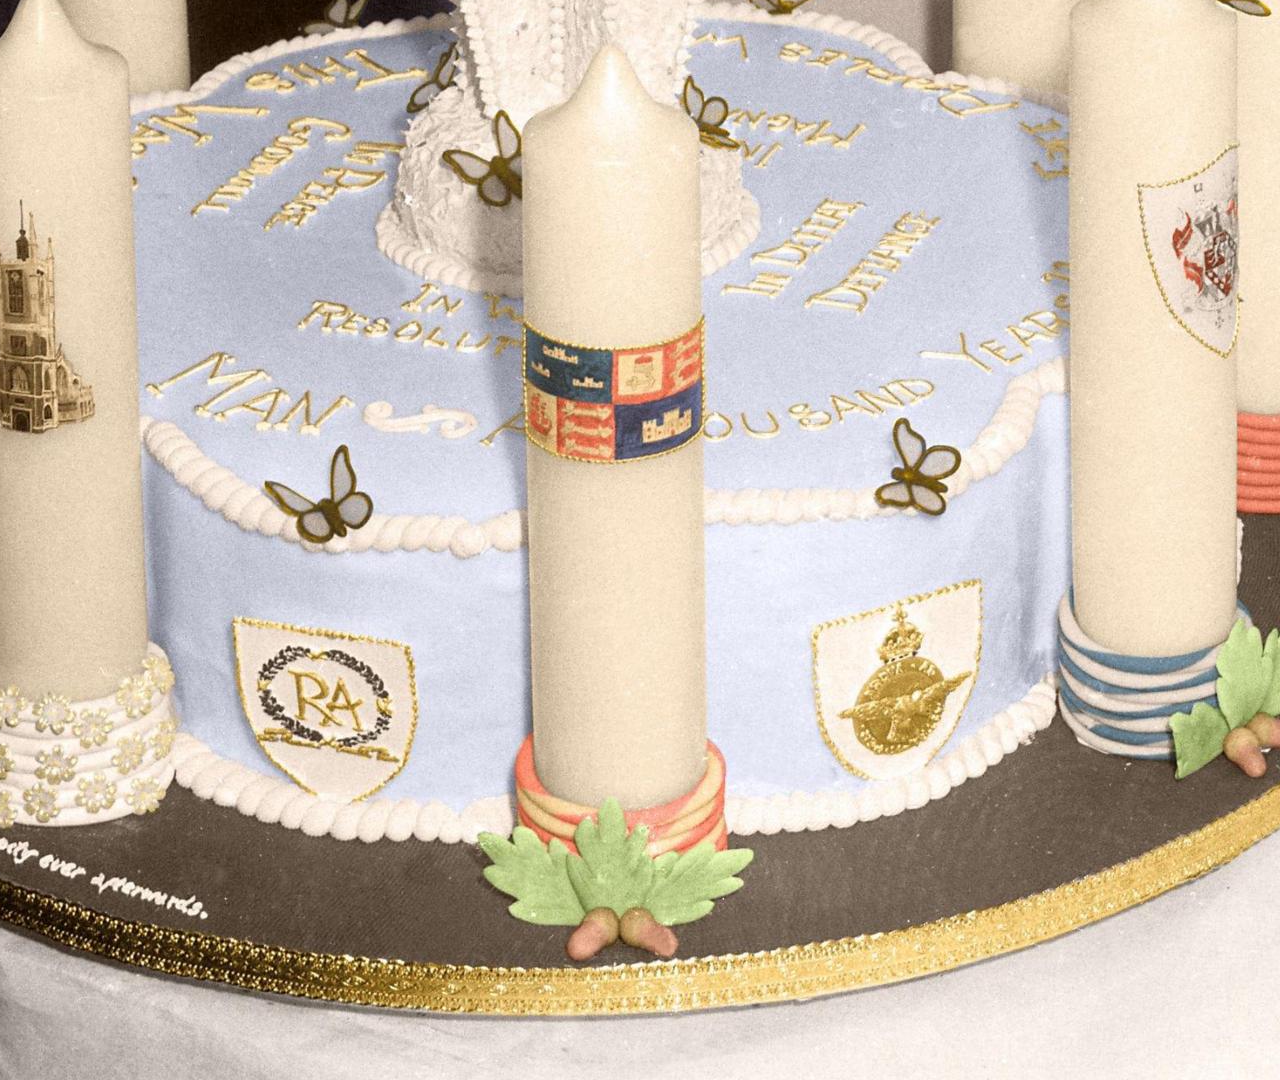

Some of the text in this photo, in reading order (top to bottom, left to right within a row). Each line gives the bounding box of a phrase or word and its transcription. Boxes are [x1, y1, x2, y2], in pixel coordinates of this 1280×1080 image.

[245, 48, 428, 94] THIS
[297, 299, 526, 356] RESOLUT
[401, 283, 464, 318] IN
[145, 351, 357, 437] MAN
[703, 377, 937, 441] OUSAND
[287, 668, 366, 733] RA
[38, 853, 87, 879] ever
[90, 872, 209, 920] afterwards.
